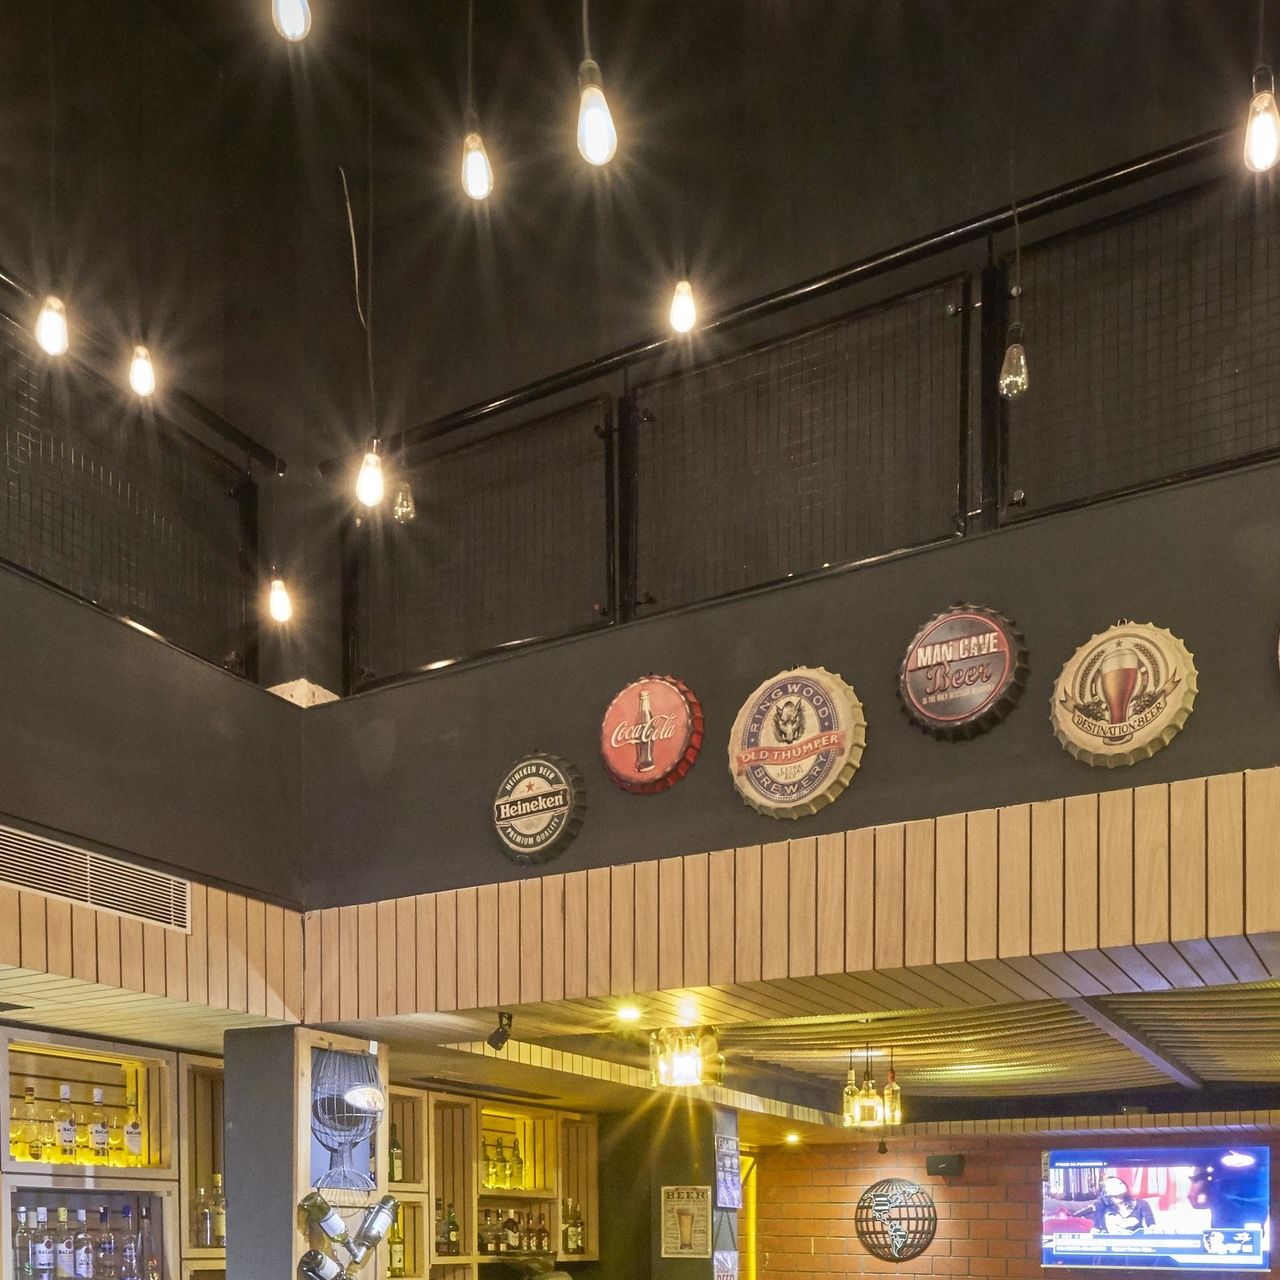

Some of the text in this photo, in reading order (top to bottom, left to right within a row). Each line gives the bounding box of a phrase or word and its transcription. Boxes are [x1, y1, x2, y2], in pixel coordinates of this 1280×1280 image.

[917, 632, 999, 667] MAN CAVE
[926, 661, 991, 695] Beer
[750, 683, 830, 733] RINGWOOD
[1075, 701, 1163, 735] DESTINATION BEER
[742, 734, 839, 762] OLD THUMPER
[505, 765, 555, 791] HEINEKEN BEER
[754, 754, 827, 795] BREWERY
[500, 793, 563, 819] Heineken
[506, 817, 559, 845] PREMIUM QUALITY
